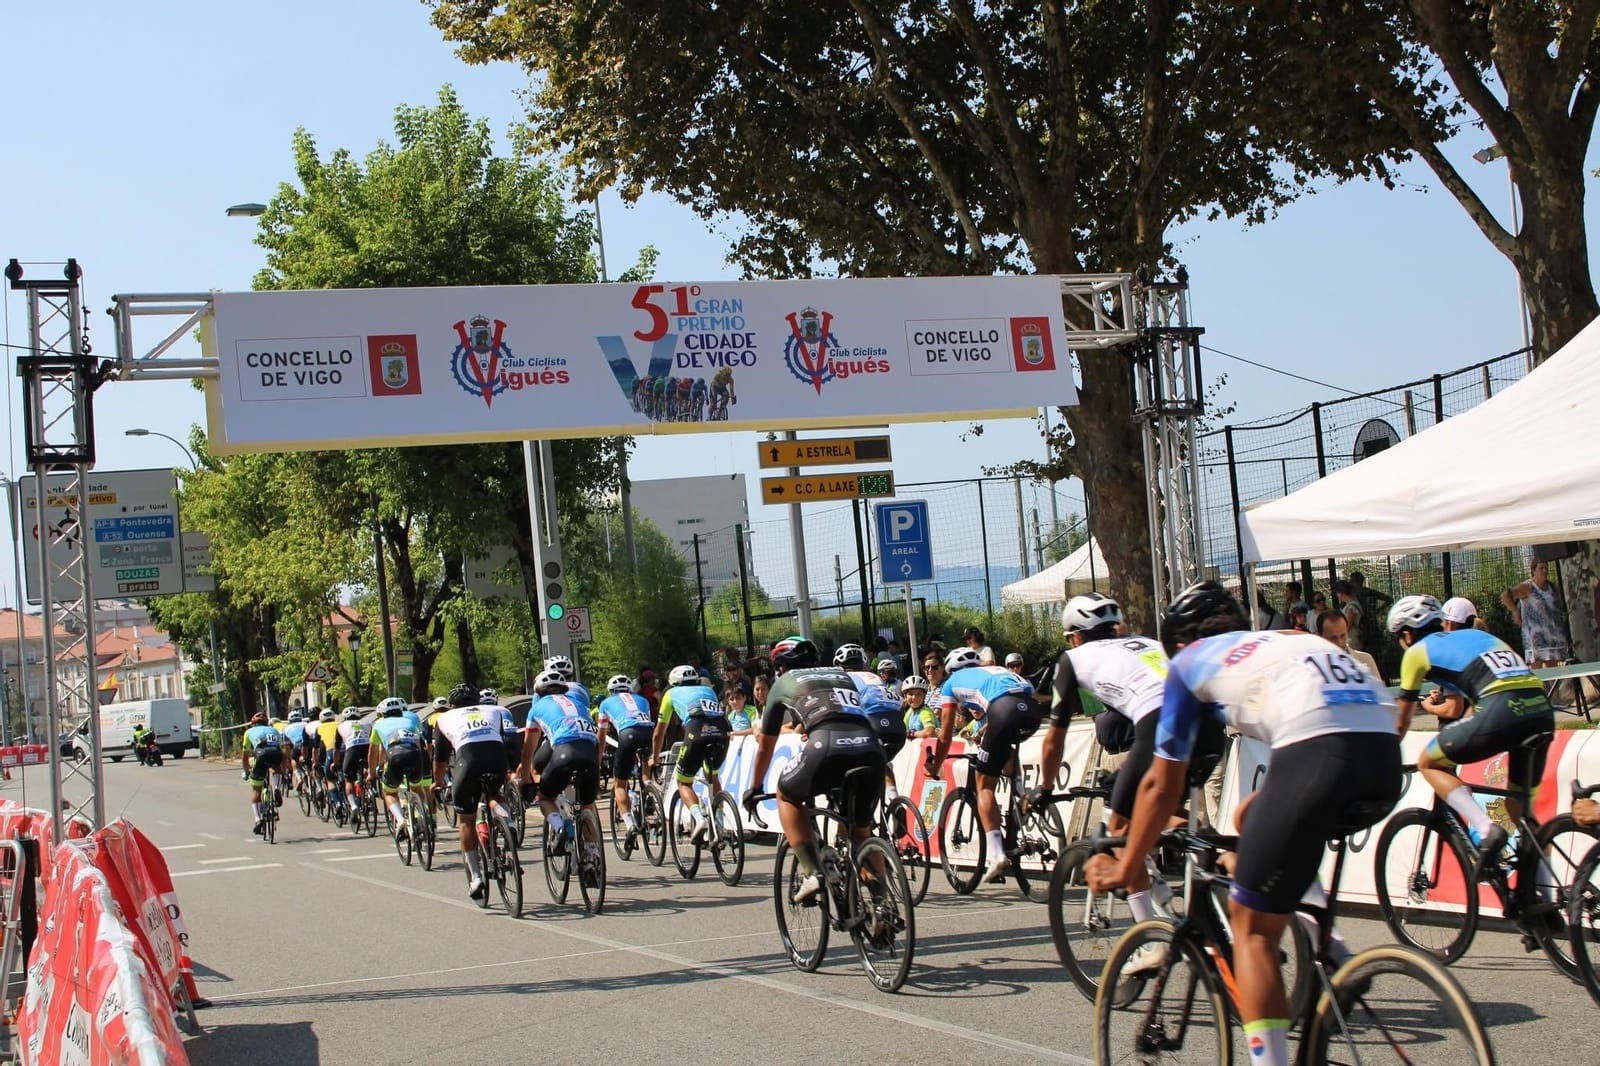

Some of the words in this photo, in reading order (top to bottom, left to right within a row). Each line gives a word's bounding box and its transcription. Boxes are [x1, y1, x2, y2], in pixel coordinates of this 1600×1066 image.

[695, 299, 743, 314] GRAN
[677, 316, 745, 331] PREMIO
[684, 332, 757, 349] CIDADE
[914, 330, 999, 345] CONCELLO
[246, 350, 352, 367] CONCELLO
[676, 352, 703, 368] DE
[706, 350, 757, 367] VIGO
[830, 348, 850, 357] Club
[853, 347, 887, 356] Ciclista
[926, 349, 948, 362] DE
[952, 347, 991, 361] VIGO
[502, 358, 524, 367] Club
[528, 357, 567, 367] Ciclista
[261, 371, 288, 387] DE
[294, 370, 342, 385] VIGO
[796, 448, 803, 458] A
[807, 445, 851, 458] ESTRELA
[795, 483, 815, 495] C.C.
[818, 482, 826, 493] A
[829, 481, 855, 493] LAXE
[120, 516, 172, 527] Pontevedra
[890, 510, 914, 540] P
[127, 530, 167, 539] Ourense
[892, 546, 919, 556] AREAL
[117, 568, 159, 579] BOUZAS
[1483, 650, 1519, 669] 157
[1304, 653, 1364, 684] 163
